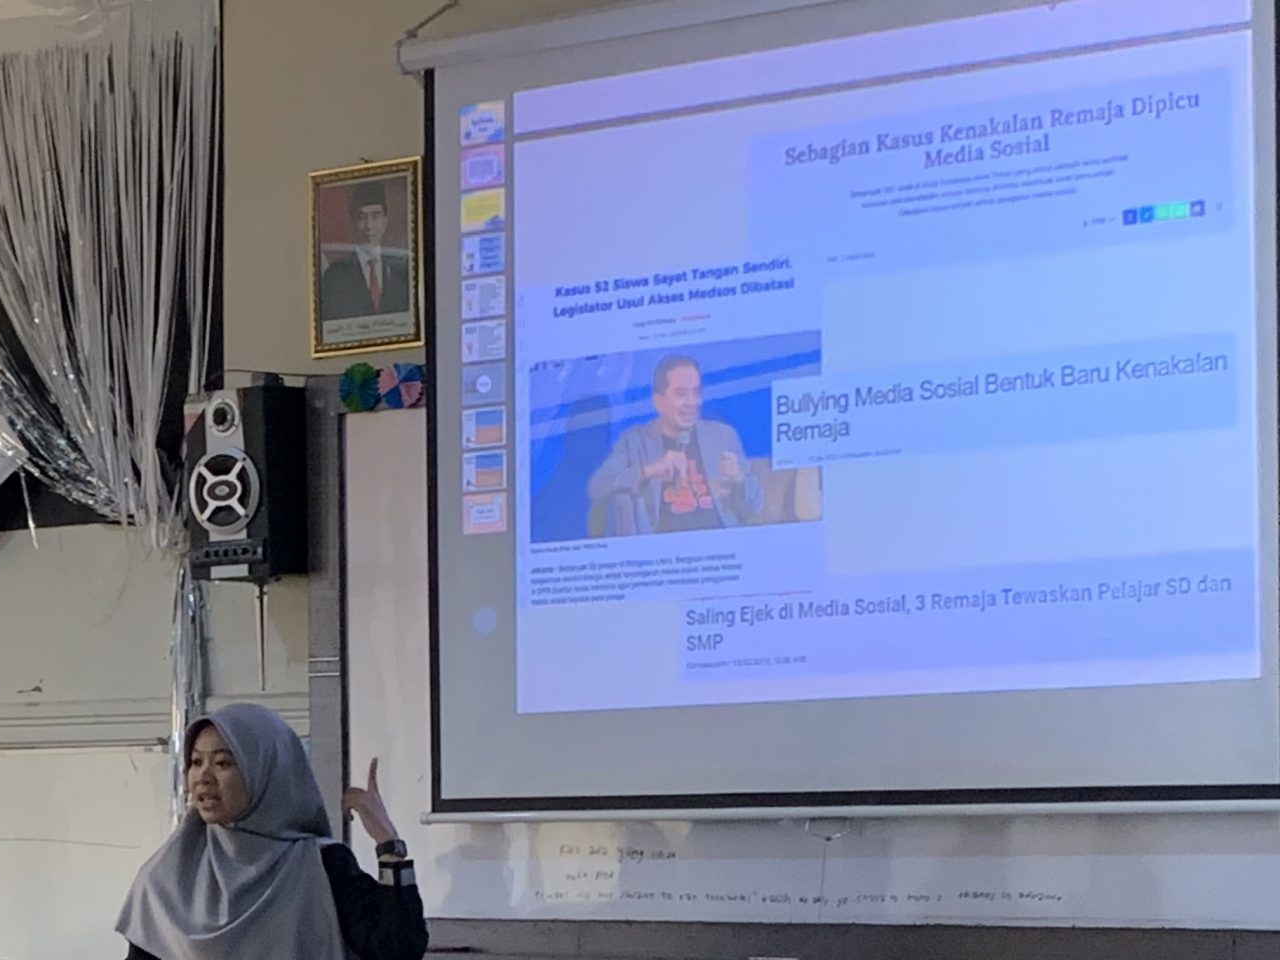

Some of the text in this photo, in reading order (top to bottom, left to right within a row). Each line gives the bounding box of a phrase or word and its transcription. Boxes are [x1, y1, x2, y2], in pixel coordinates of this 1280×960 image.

[785, 92, 1201, 167] Sebagian Kasus Kenakalan Remaja Dipicu
[924, 133, 1051, 169] Media Sosial
[553, 276, 795, 319] Legislator Usul Akses Medsos Dibatasi
[555, 284, 591, 298] Kasus
[594, 281, 610, 294] 52
[613, 276, 649, 292] Siswa
[652, 271, 688, 287] Sayat
[691, 264, 739, 281] Tangan
[776, 351, 1229, 419] Bullying Media Sosial Bentuk Baru Kenakalan
[776, 415, 851, 445] Remaja
[686, 574, 1232, 628] Saling Ejek di Media Sosial, 3 Remaja Tewaskan Pelajar SD dan
[686, 633, 724, 652] SMP
